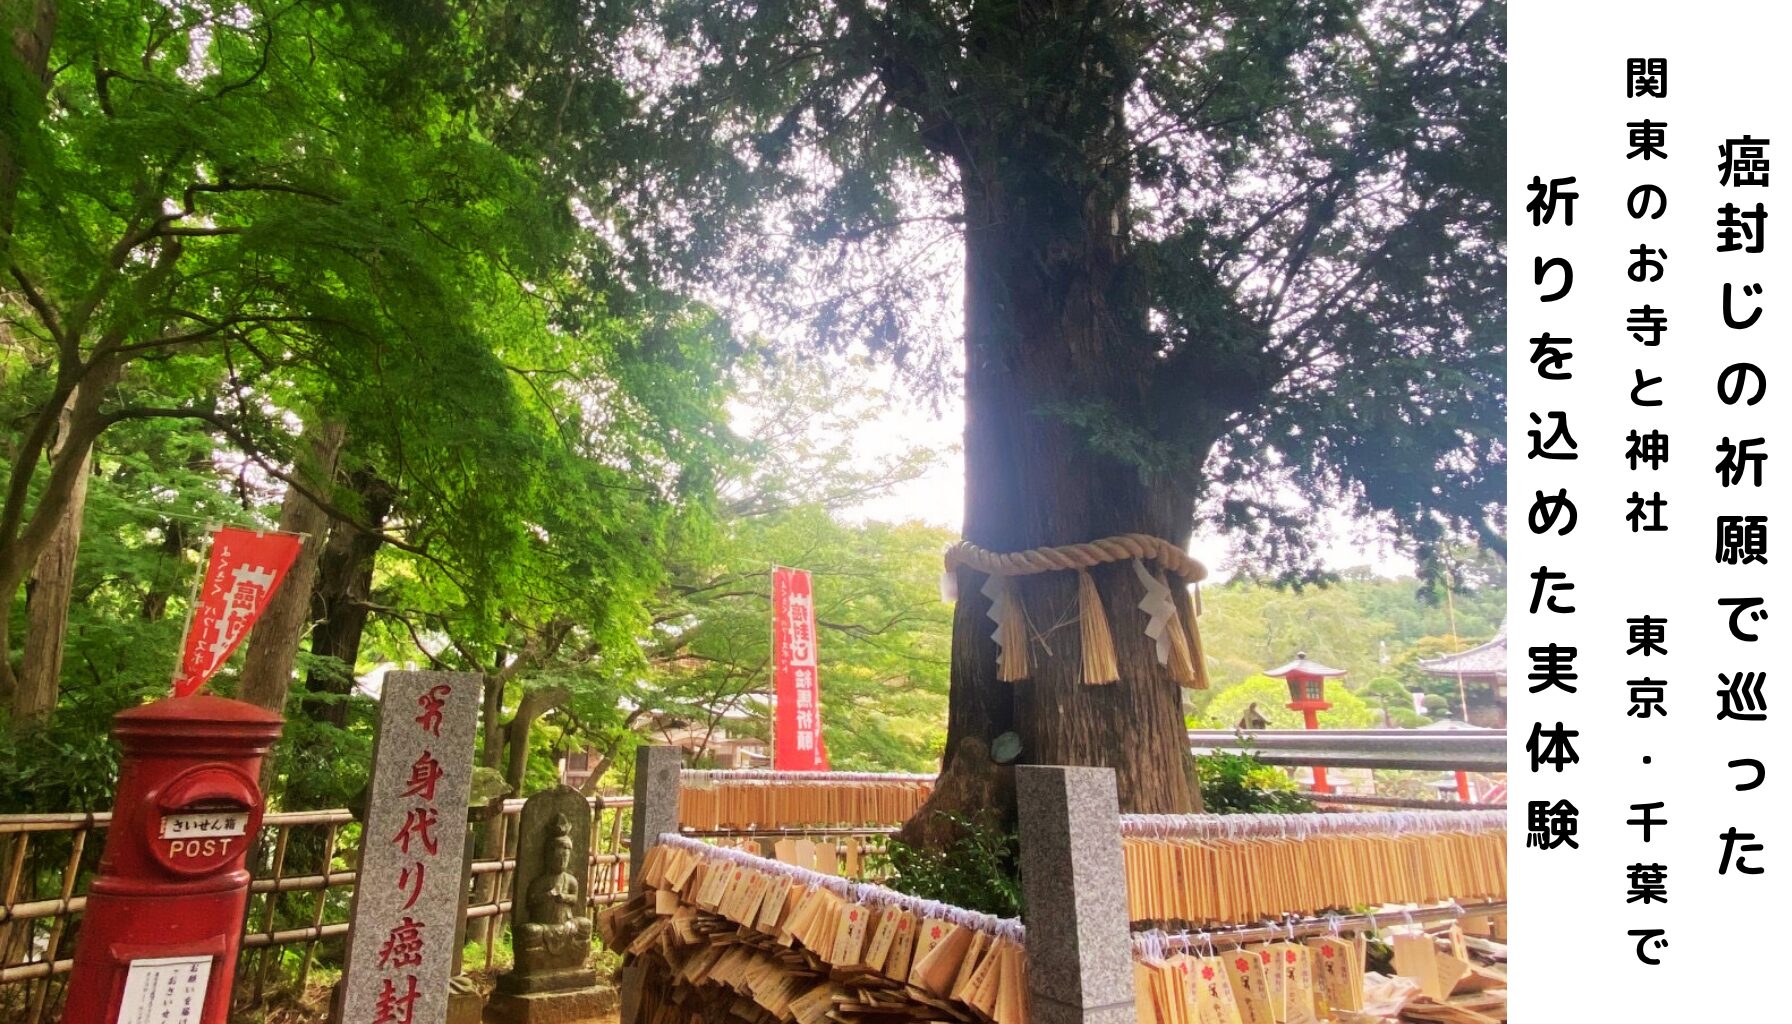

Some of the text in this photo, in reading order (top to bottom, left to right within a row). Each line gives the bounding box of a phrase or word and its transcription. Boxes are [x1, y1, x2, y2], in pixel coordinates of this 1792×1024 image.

[172, 817, 237, 833] さいせん箱
[169, 838, 232, 859] POST
[372, 750, 444, 1024] 身代り癌封
